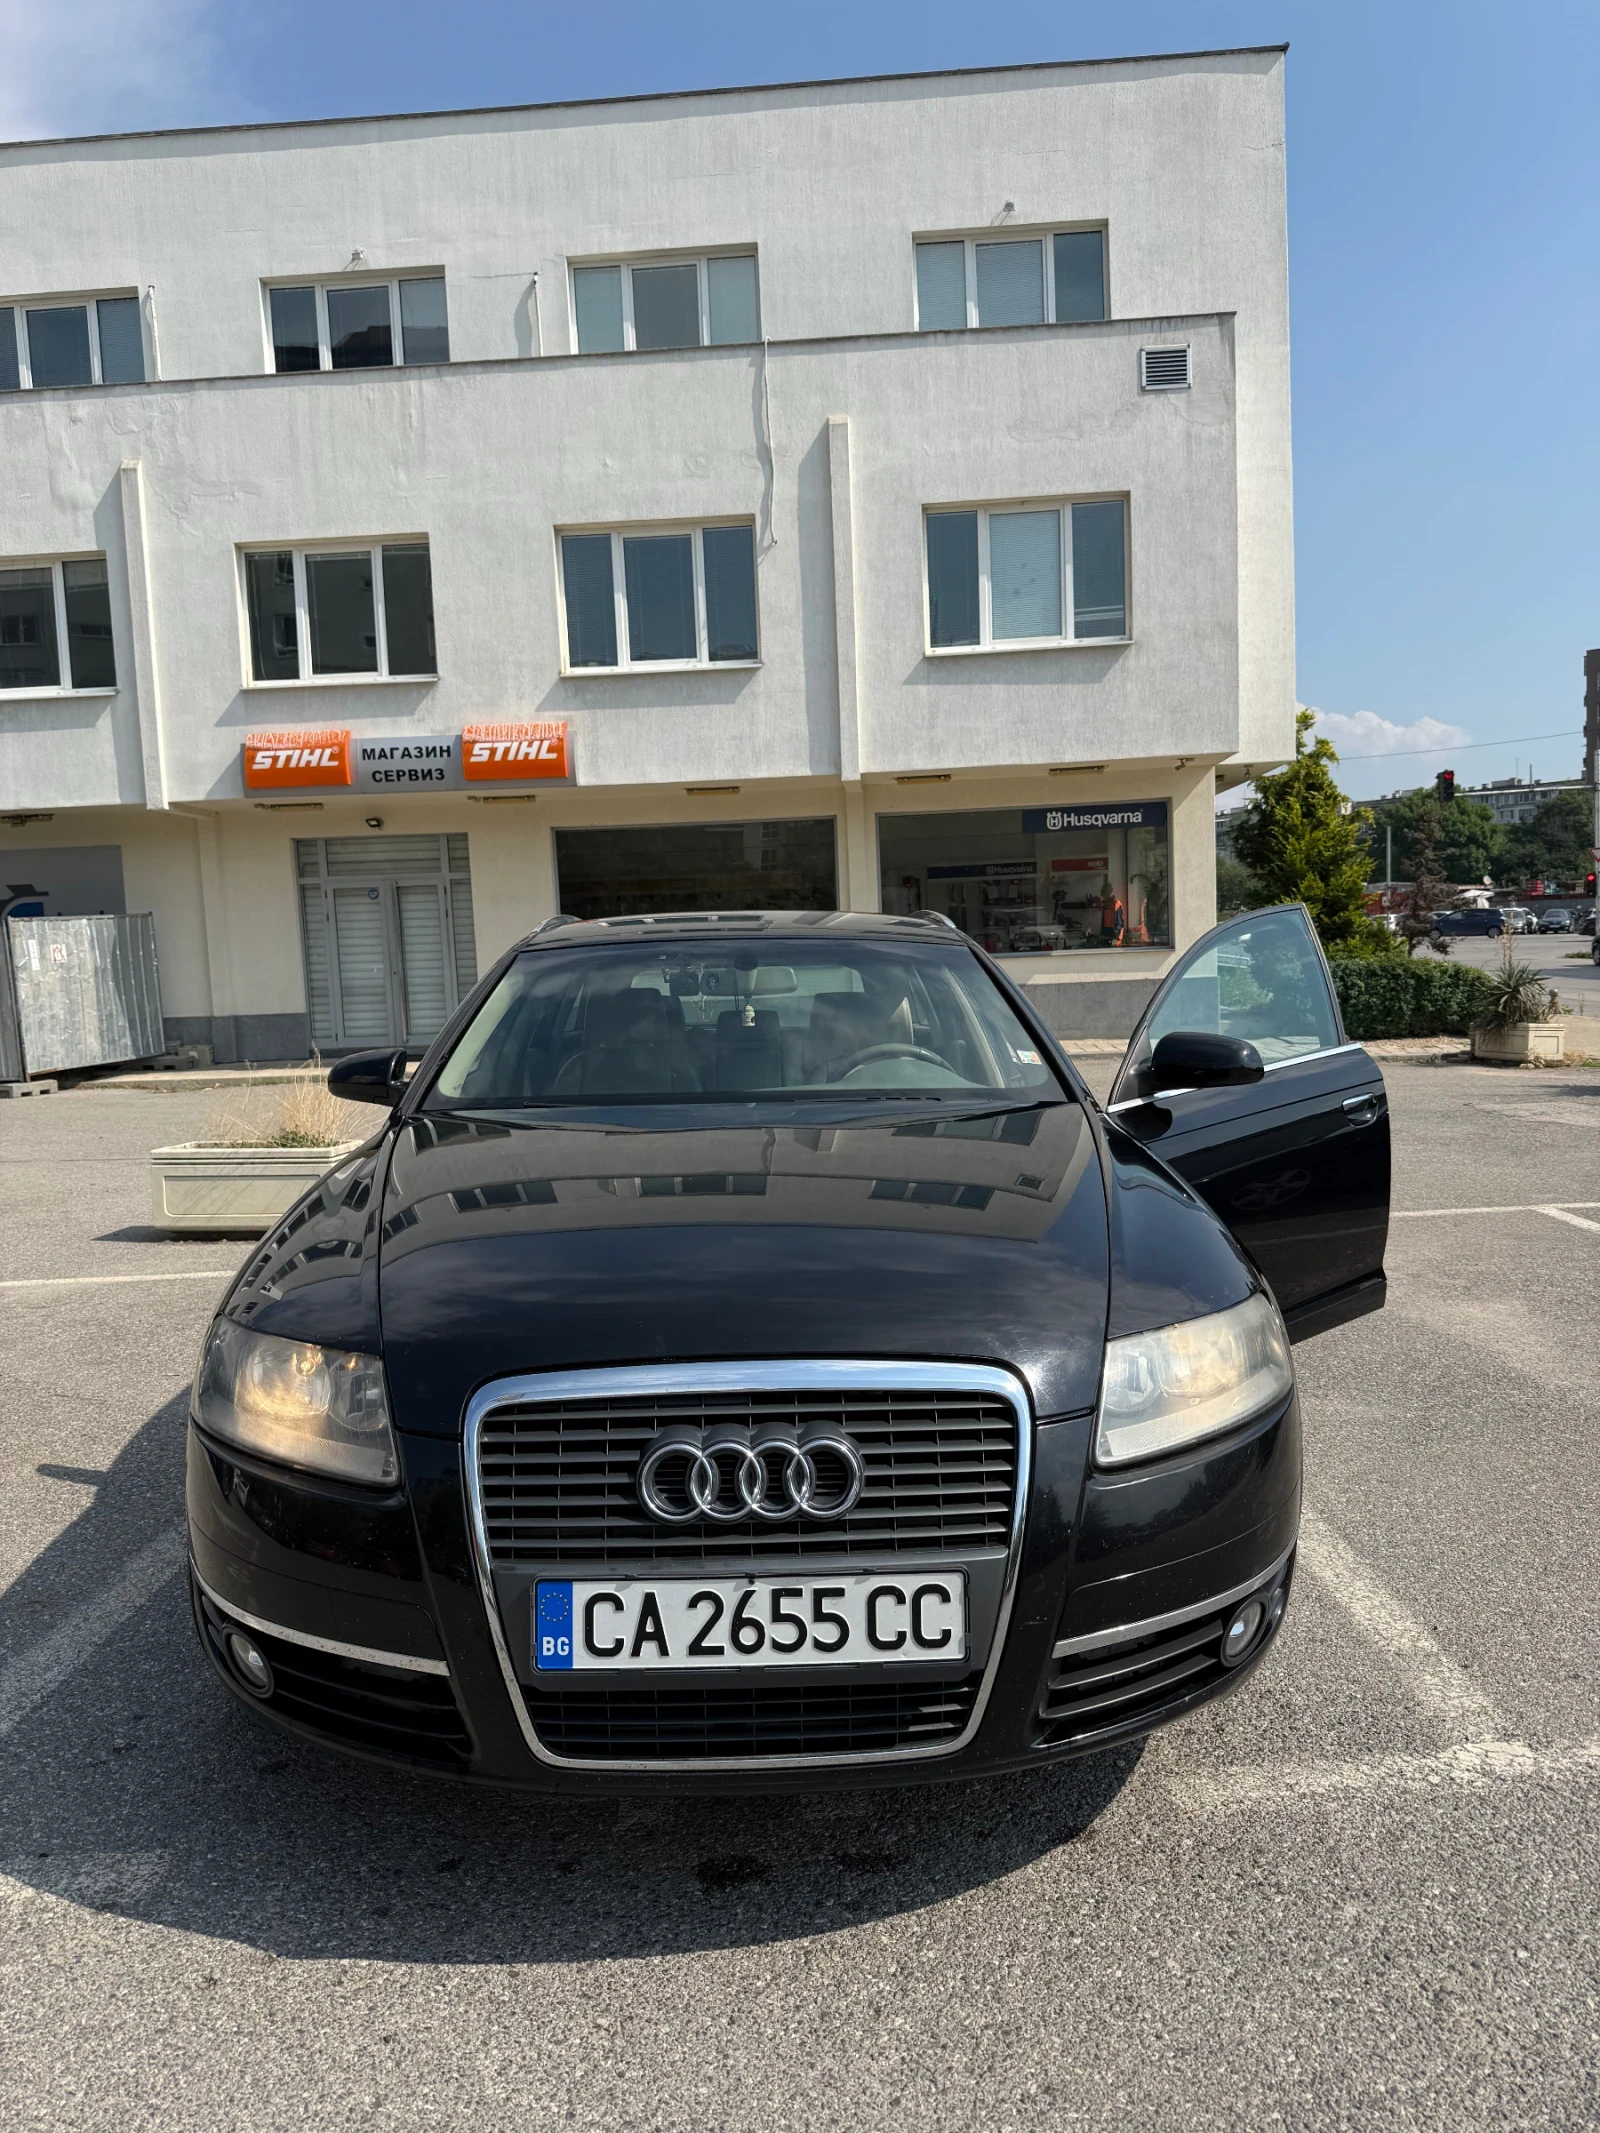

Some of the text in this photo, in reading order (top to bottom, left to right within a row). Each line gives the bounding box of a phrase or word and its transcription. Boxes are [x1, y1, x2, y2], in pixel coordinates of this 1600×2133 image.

[252, 748, 340, 770] STIHL
[362, 745, 452, 761] МАГАЗИН
[469, 740, 558, 762] STIHL
[372, 768, 445, 783] СЕРВИЗ
[1063, 811, 1143, 828] Husqvarna
[994, 865, 1033, 874] Husqvarna
[584, 1583, 952, 1657] CA 2655 CC
[542, 1636, 570, 1656] BG
